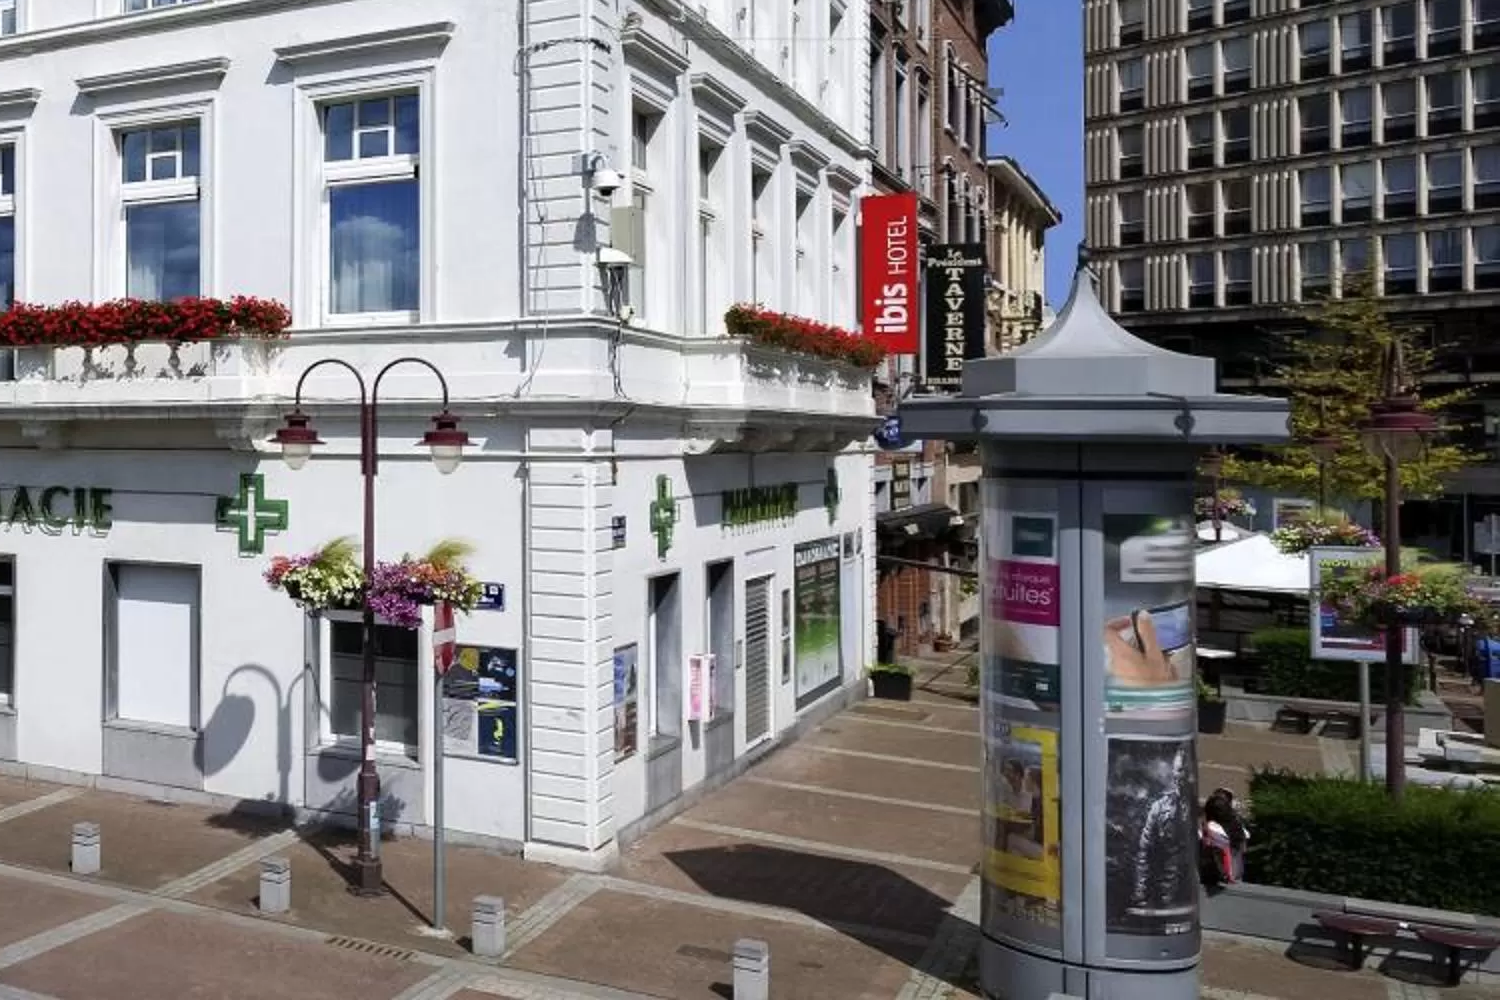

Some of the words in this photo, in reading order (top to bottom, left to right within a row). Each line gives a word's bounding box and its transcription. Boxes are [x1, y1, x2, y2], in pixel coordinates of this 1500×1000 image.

[887, 215, 908, 275] HOTEL
[874, 283, 908, 333] ibis
[944, 267, 965, 371] TAVERNE
